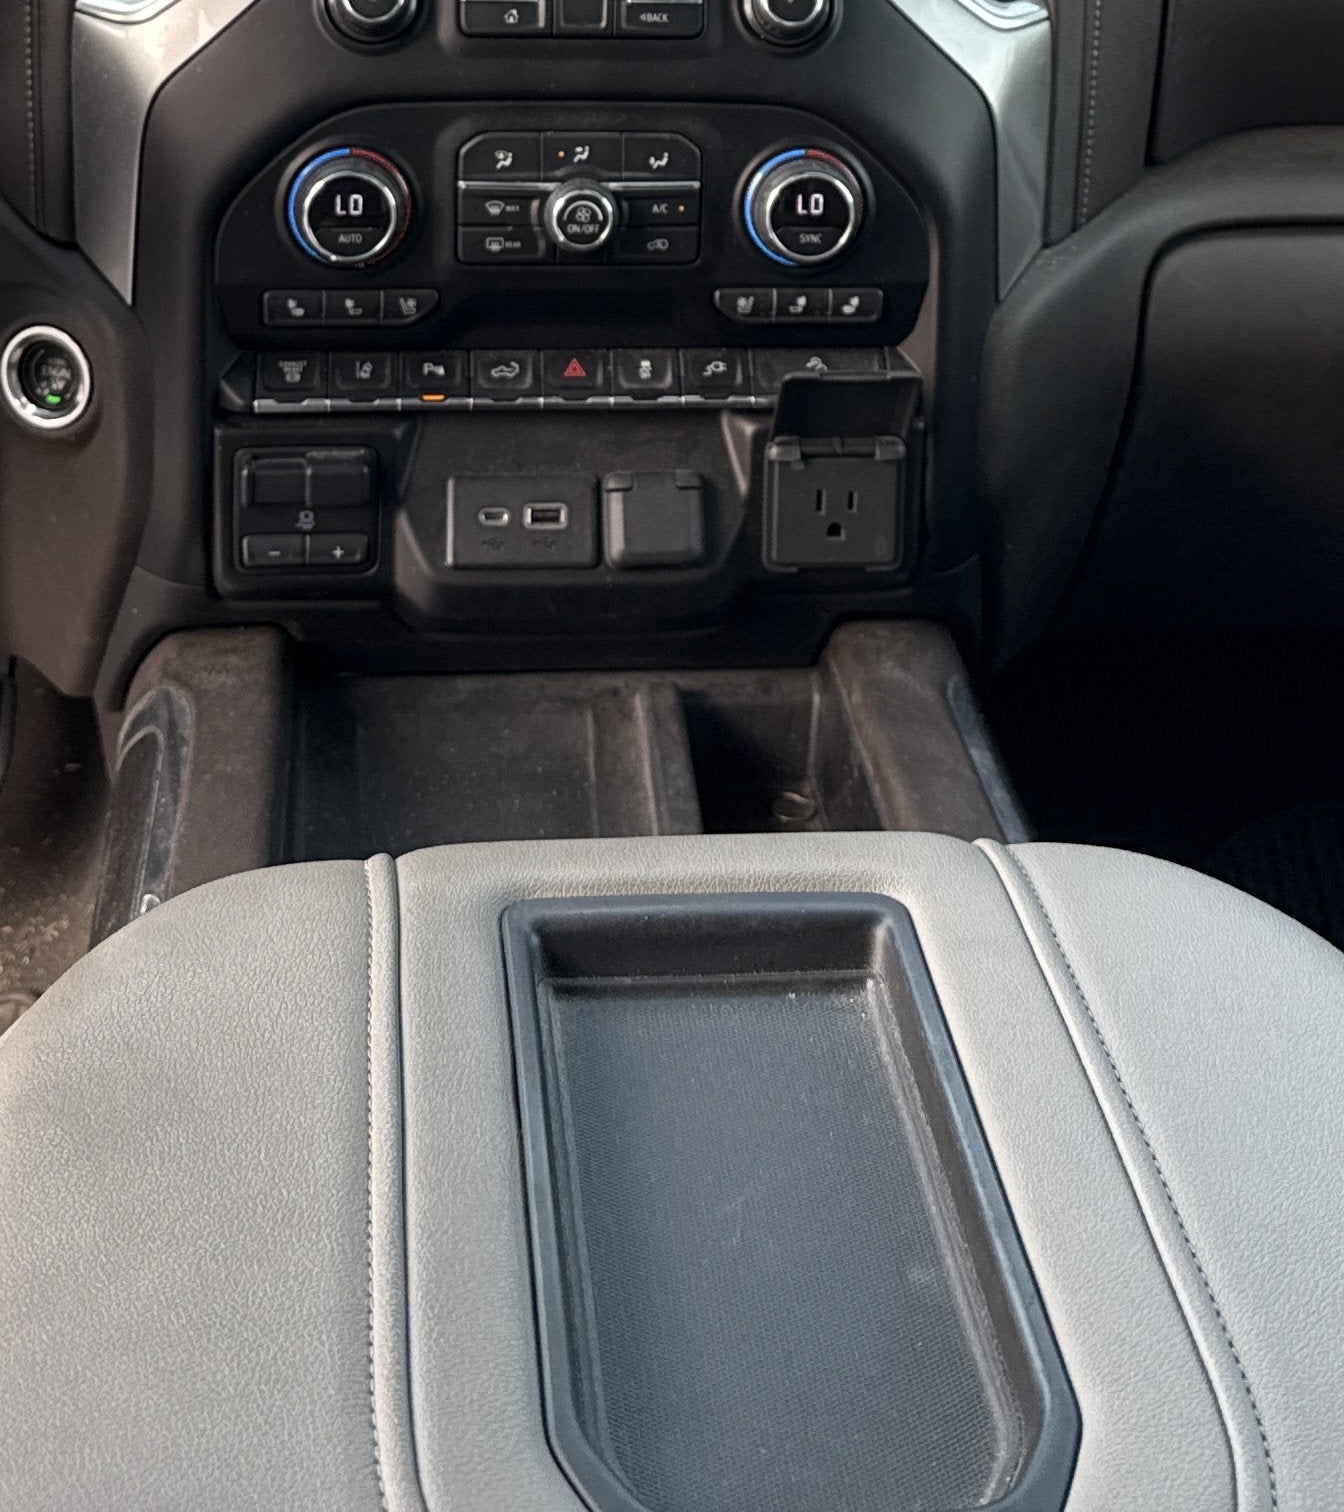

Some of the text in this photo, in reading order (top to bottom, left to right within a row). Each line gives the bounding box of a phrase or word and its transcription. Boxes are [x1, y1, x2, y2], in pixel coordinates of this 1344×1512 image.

[646, 12, 669, 23] BACK
[335, 193, 364, 216] LO
[652, 203, 668, 214] A/C
[797, 193, 824, 216] LO
[567, 224, 600, 234] ON/OFF
[338, 233, 363, 243] AUTO
[799, 233, 823, 243] SYNC
